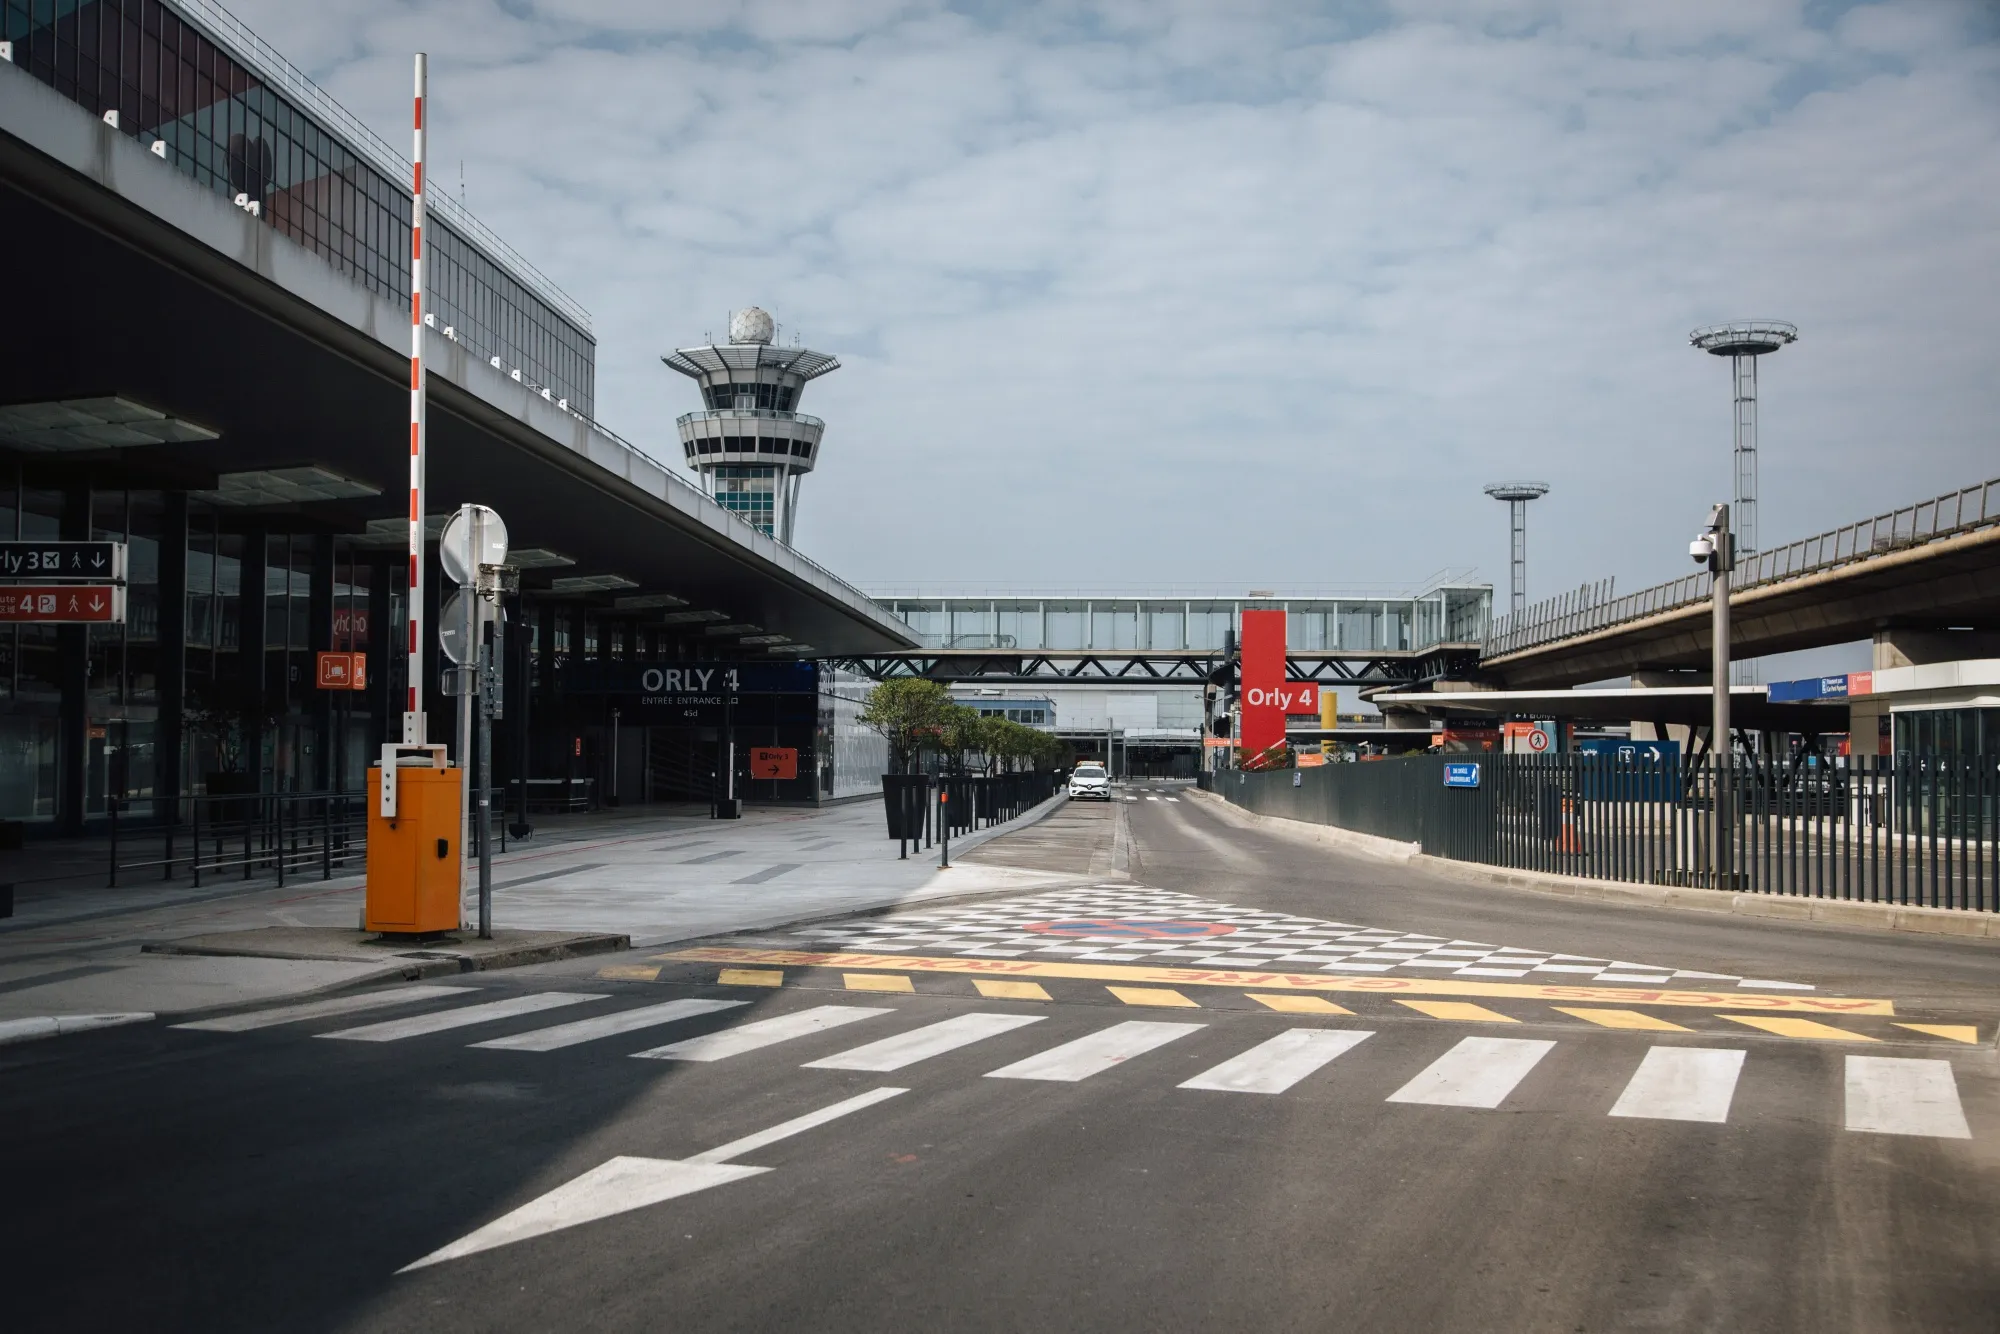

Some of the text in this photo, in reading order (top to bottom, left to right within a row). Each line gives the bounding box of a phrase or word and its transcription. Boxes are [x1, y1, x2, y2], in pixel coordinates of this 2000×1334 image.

[27, 551, 39, 569] 3
[20, 594, 34, 613] 4
[642, 668, 740, 692] ORLY 4
[641, 696, 721, 705] ENTRÉE ENTRANCE
[1248, 688, 1312, 710] Orly 4
[768, 753, 783, 761] Orly
[1145, 970, 1412, 989] GARE
[1539, 987, 1878, 1011] ACCES
